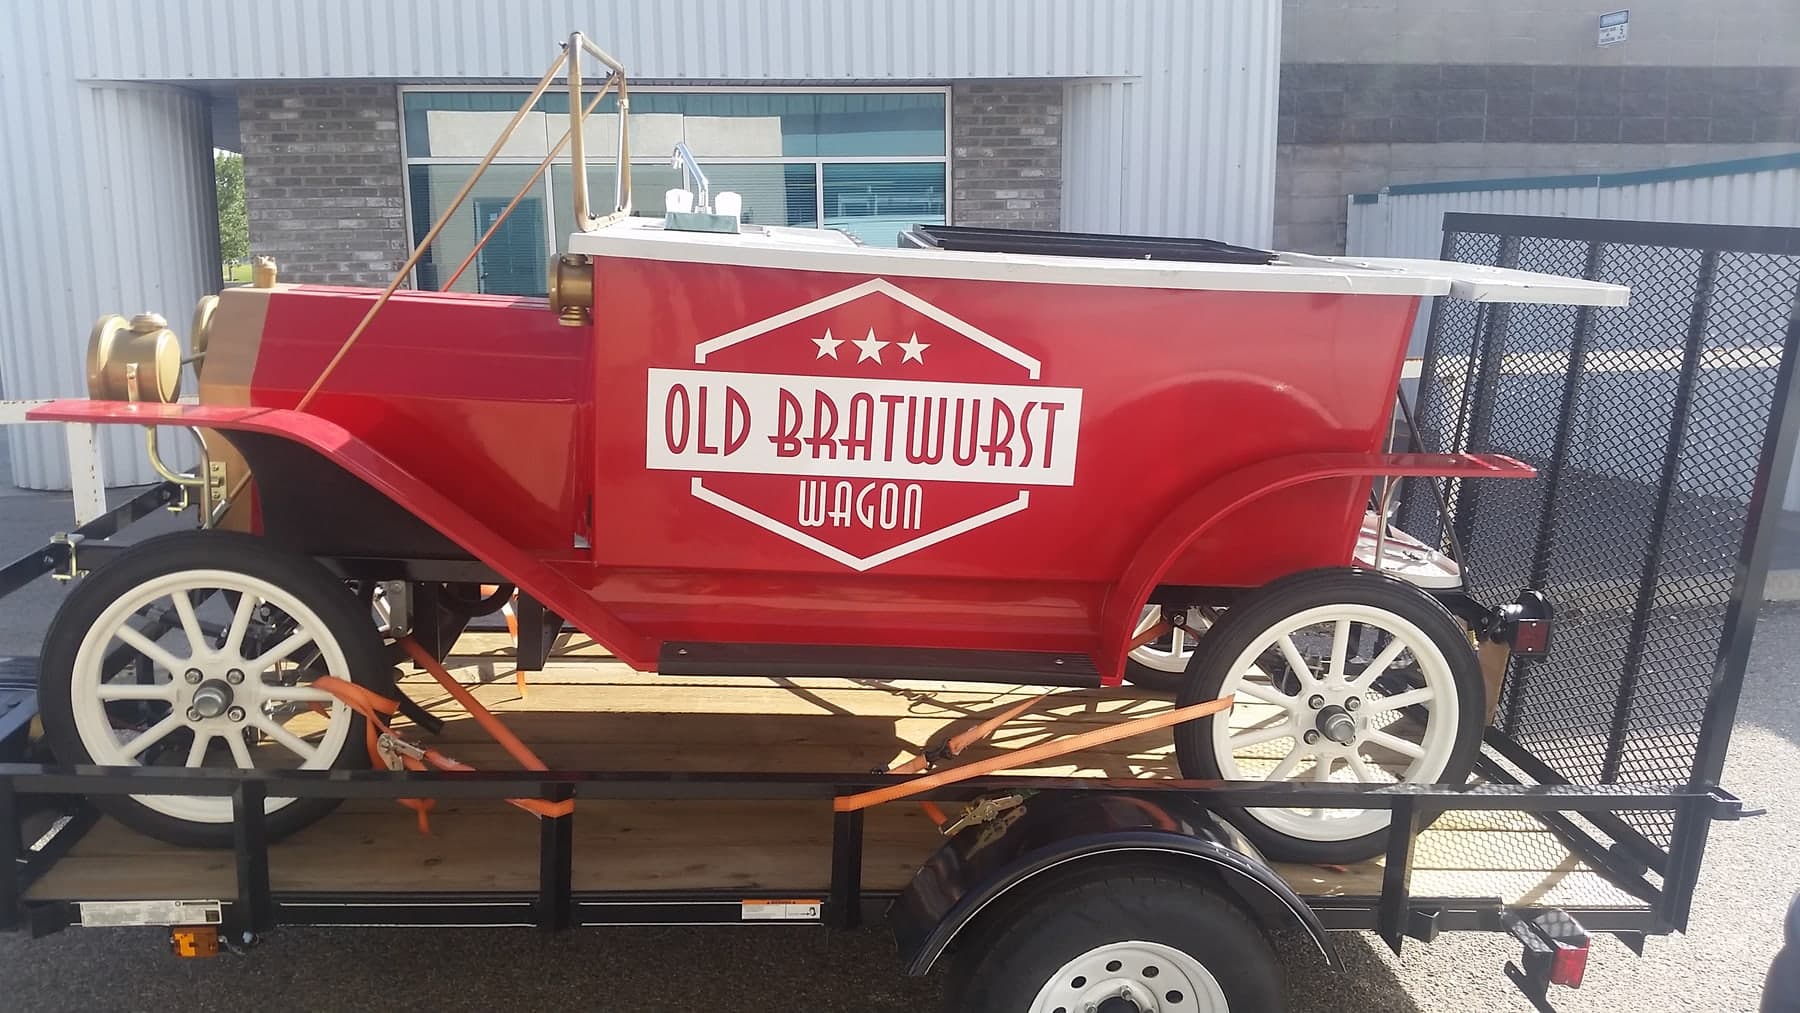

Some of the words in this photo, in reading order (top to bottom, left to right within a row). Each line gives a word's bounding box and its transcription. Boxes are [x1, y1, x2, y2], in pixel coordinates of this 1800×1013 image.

[665, 383, 751, 456] OLD
[768, 387, 1065, 469] BRATWURST
[798, 480, 923, 530] WAGON
